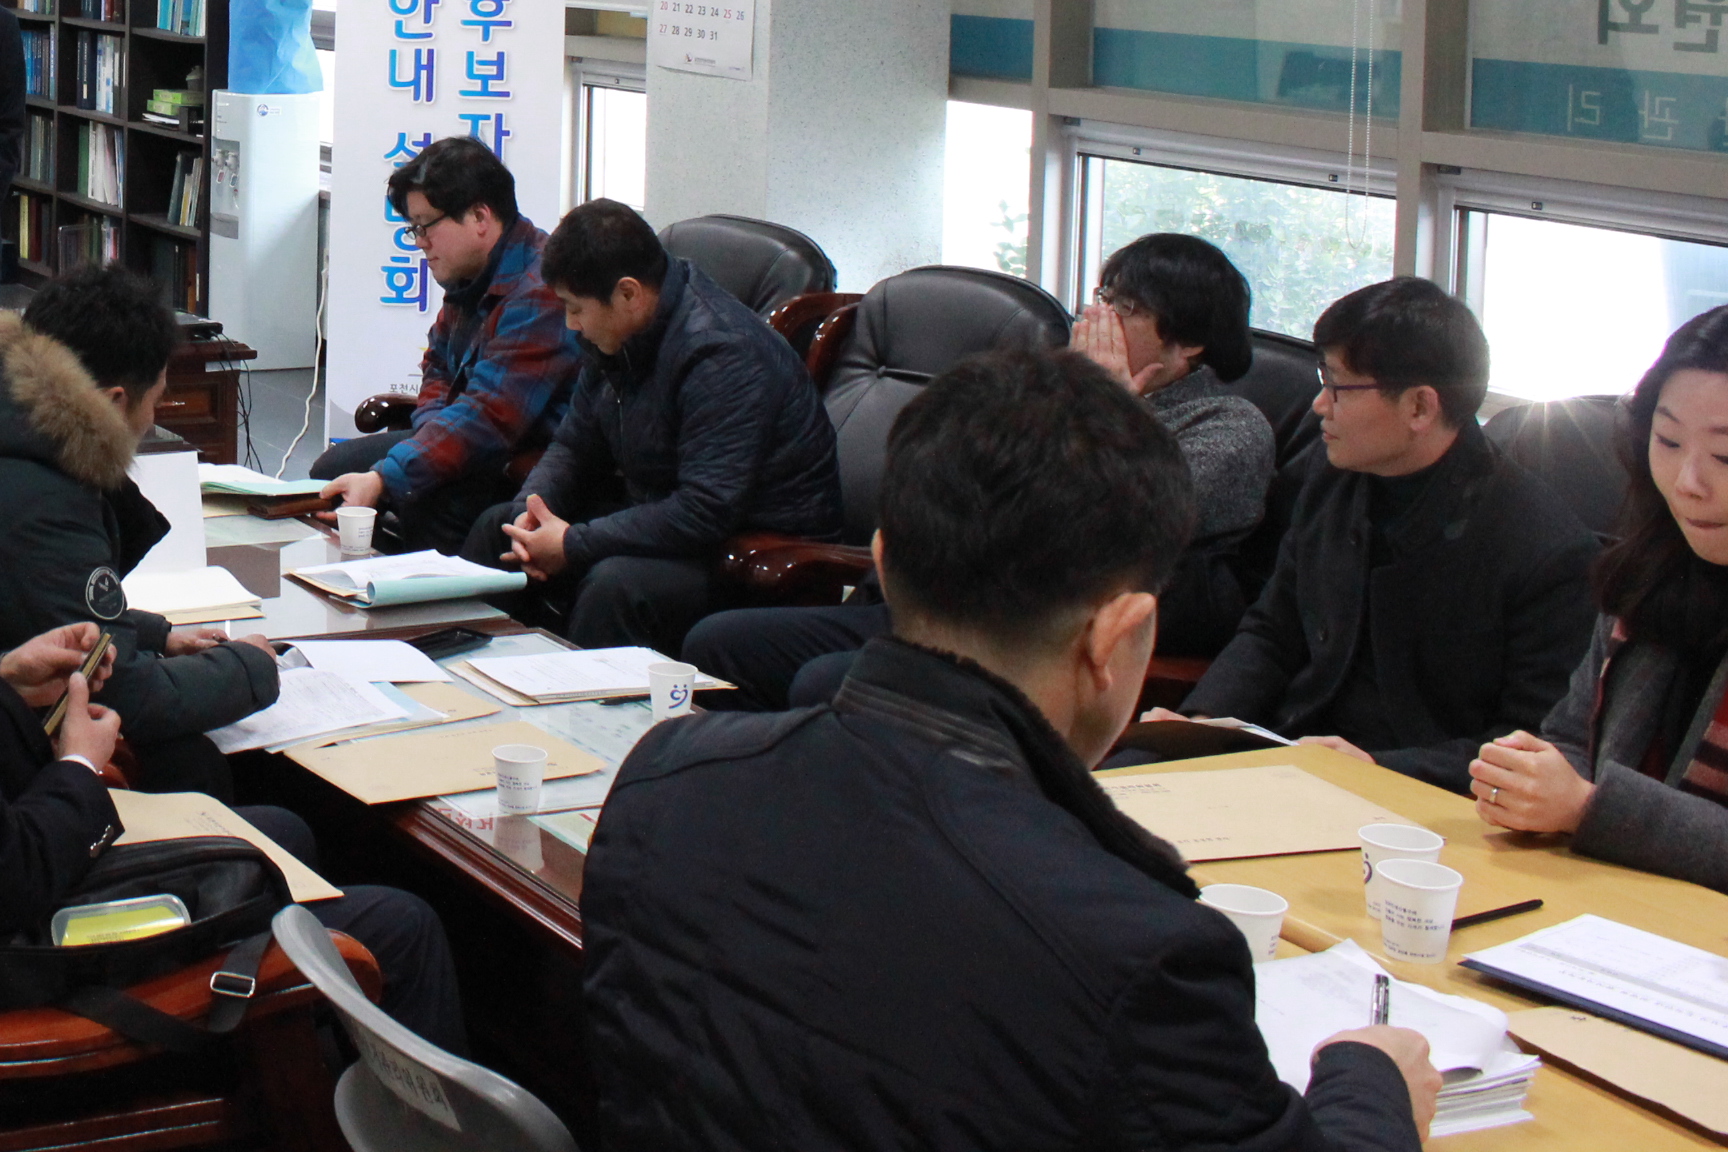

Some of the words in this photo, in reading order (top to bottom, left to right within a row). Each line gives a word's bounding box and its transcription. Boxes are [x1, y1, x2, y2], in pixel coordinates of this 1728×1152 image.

[660, 1, 668, 10] 20
[672, 2, 680, 12] 21
[685, 4, 693, 14] 22
[698, 5, 706, 16] 23
[710, 7, 719, 17] 24
[723, 9, 732, 19] 25
[736, 11, 744, 21] 26
[659, 24, 667, 33] 27
[672, 26, 680, 35] 28
[684, 27, 692, 37] 29
[697, 29, 705, 39] 30
[709, 30, 718, 40] 31
